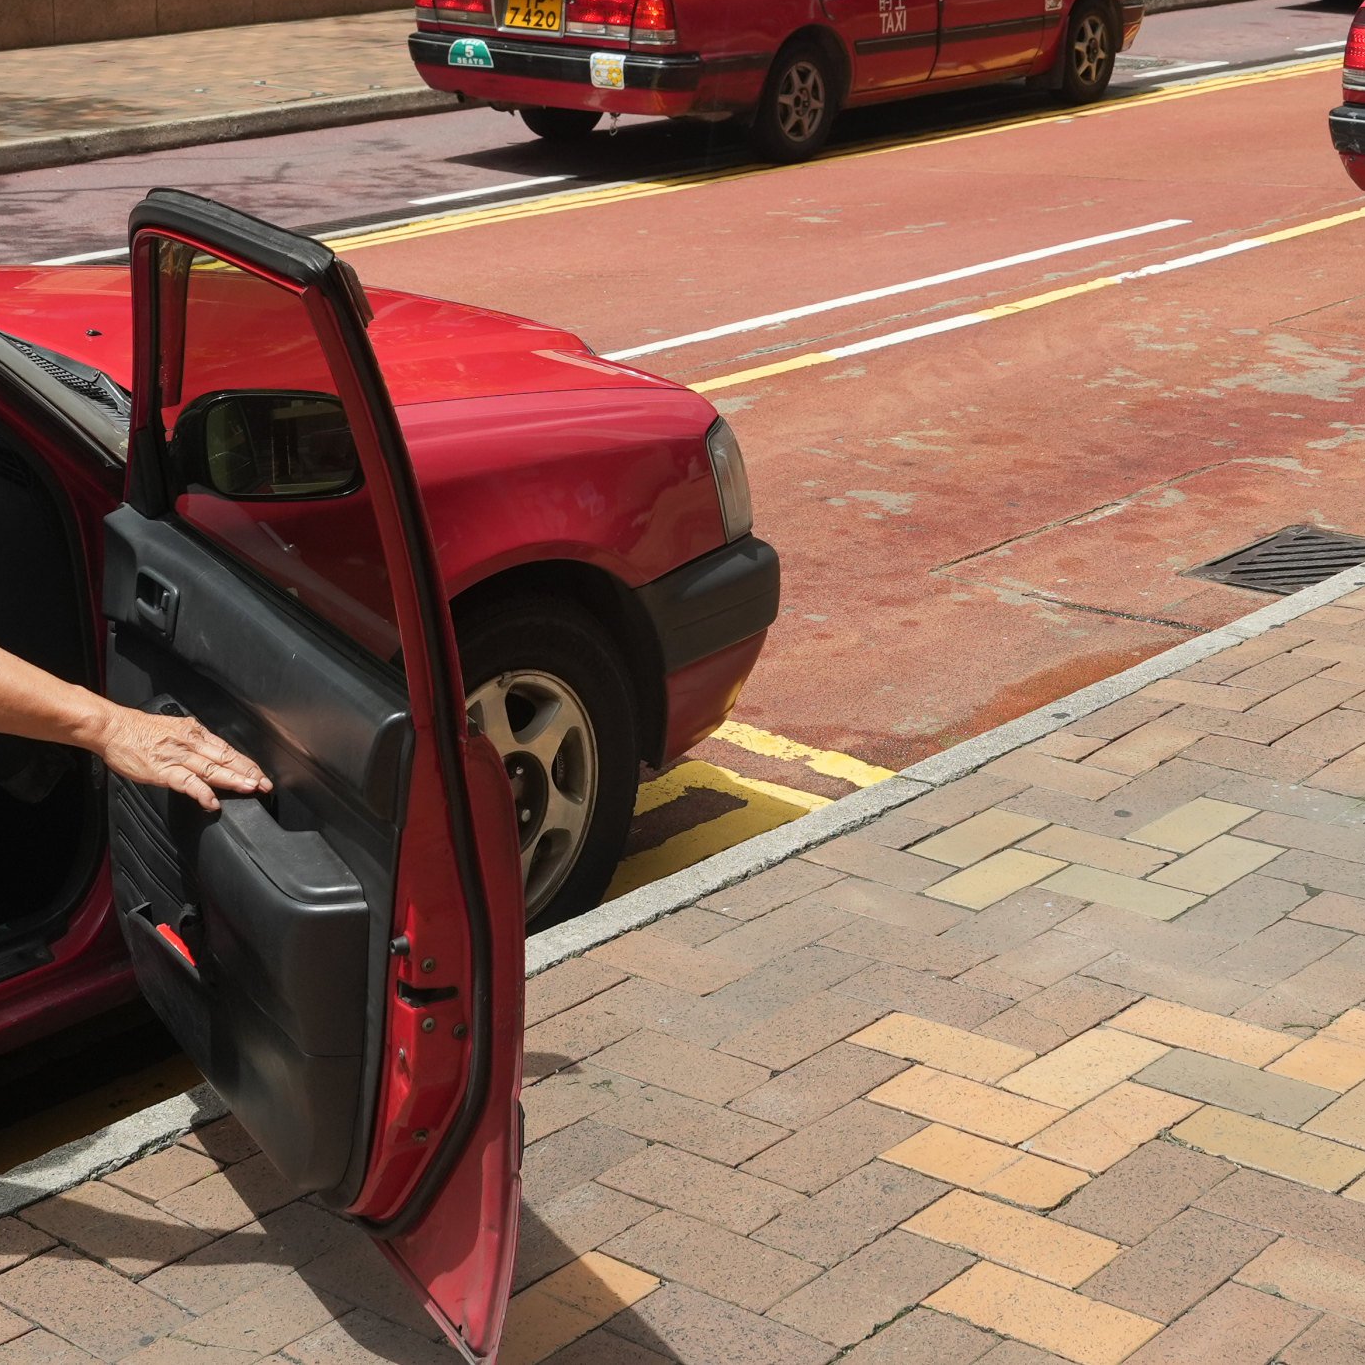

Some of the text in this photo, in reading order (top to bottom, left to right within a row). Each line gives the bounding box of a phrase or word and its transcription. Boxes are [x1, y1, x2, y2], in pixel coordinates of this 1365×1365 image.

[508, 7, 557, 28] 7420
[879, 10, 907, 34] TAXI
[465, 45, 474, 57] 5
[457, 57, 485, 66] SEATS
